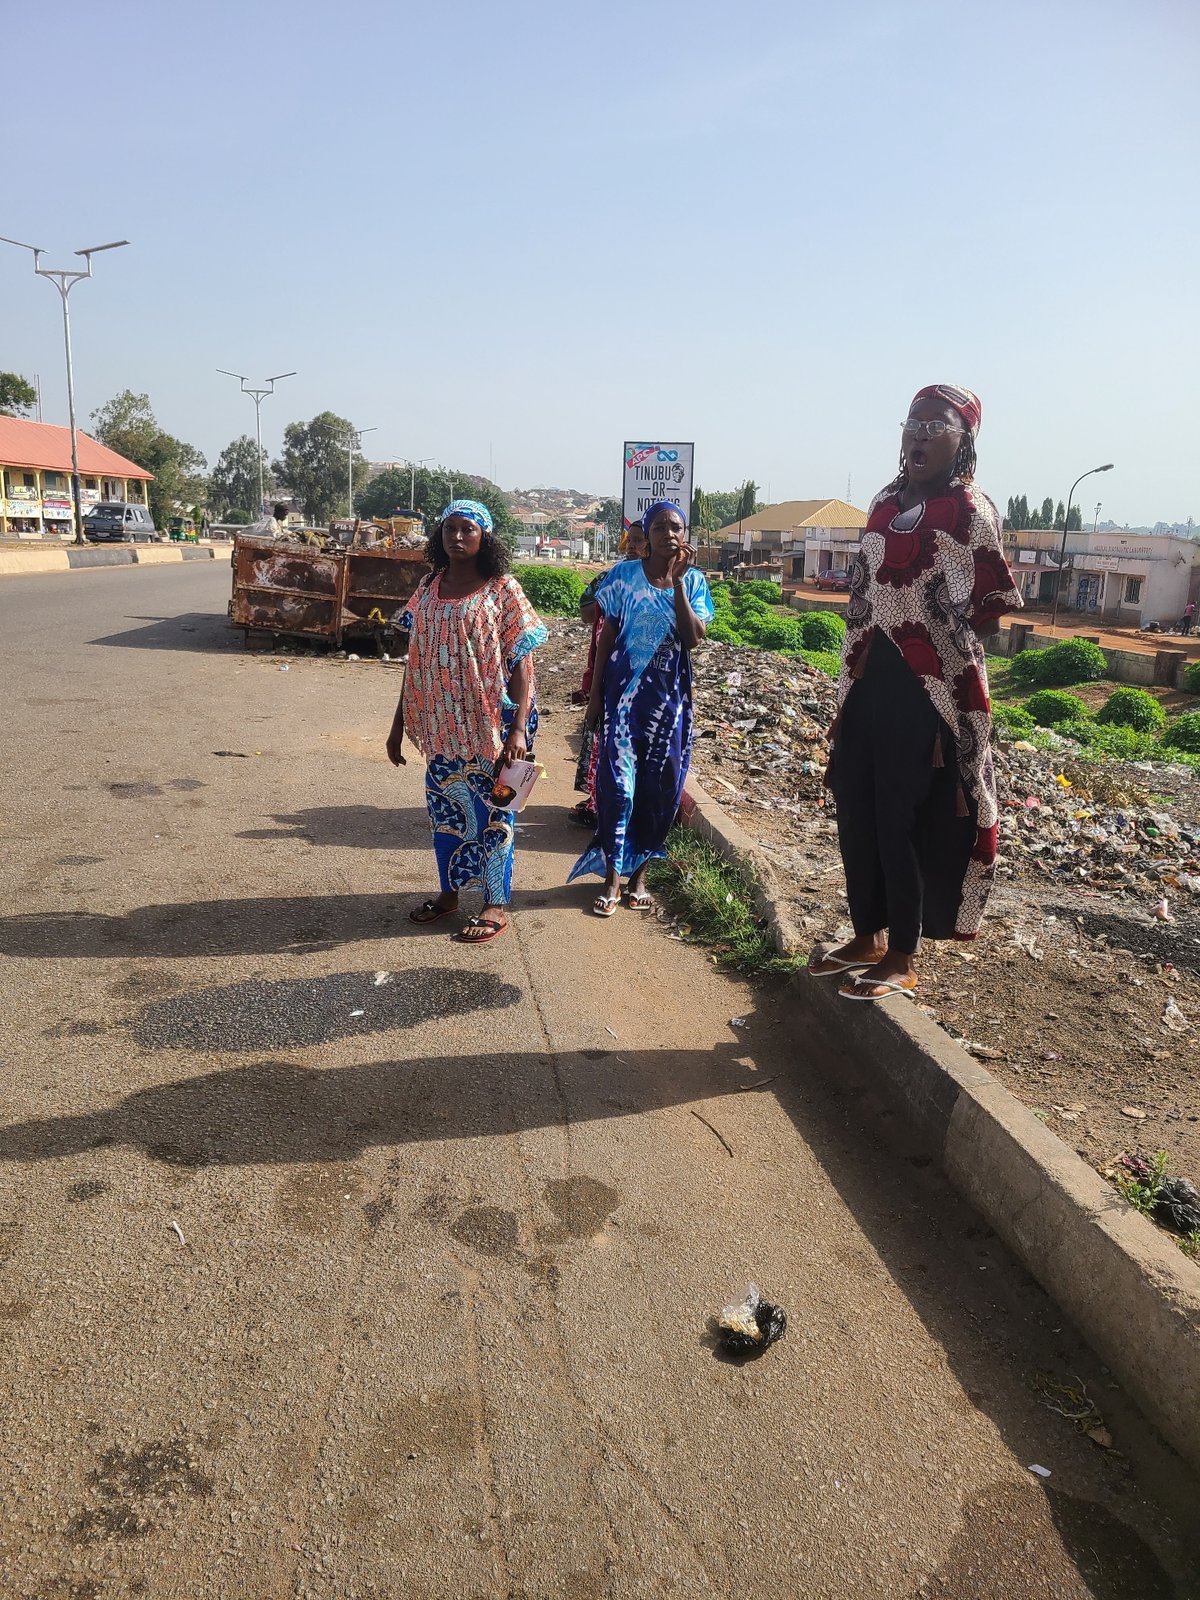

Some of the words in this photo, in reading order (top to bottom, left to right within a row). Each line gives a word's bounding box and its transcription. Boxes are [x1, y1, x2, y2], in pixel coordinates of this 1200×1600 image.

[632, 449, 650, 465] APC
[634, 465, 671, 481] TINUBU
[652, 481, 666, 497] OR
[637, 497, 680, 512] NOTG
